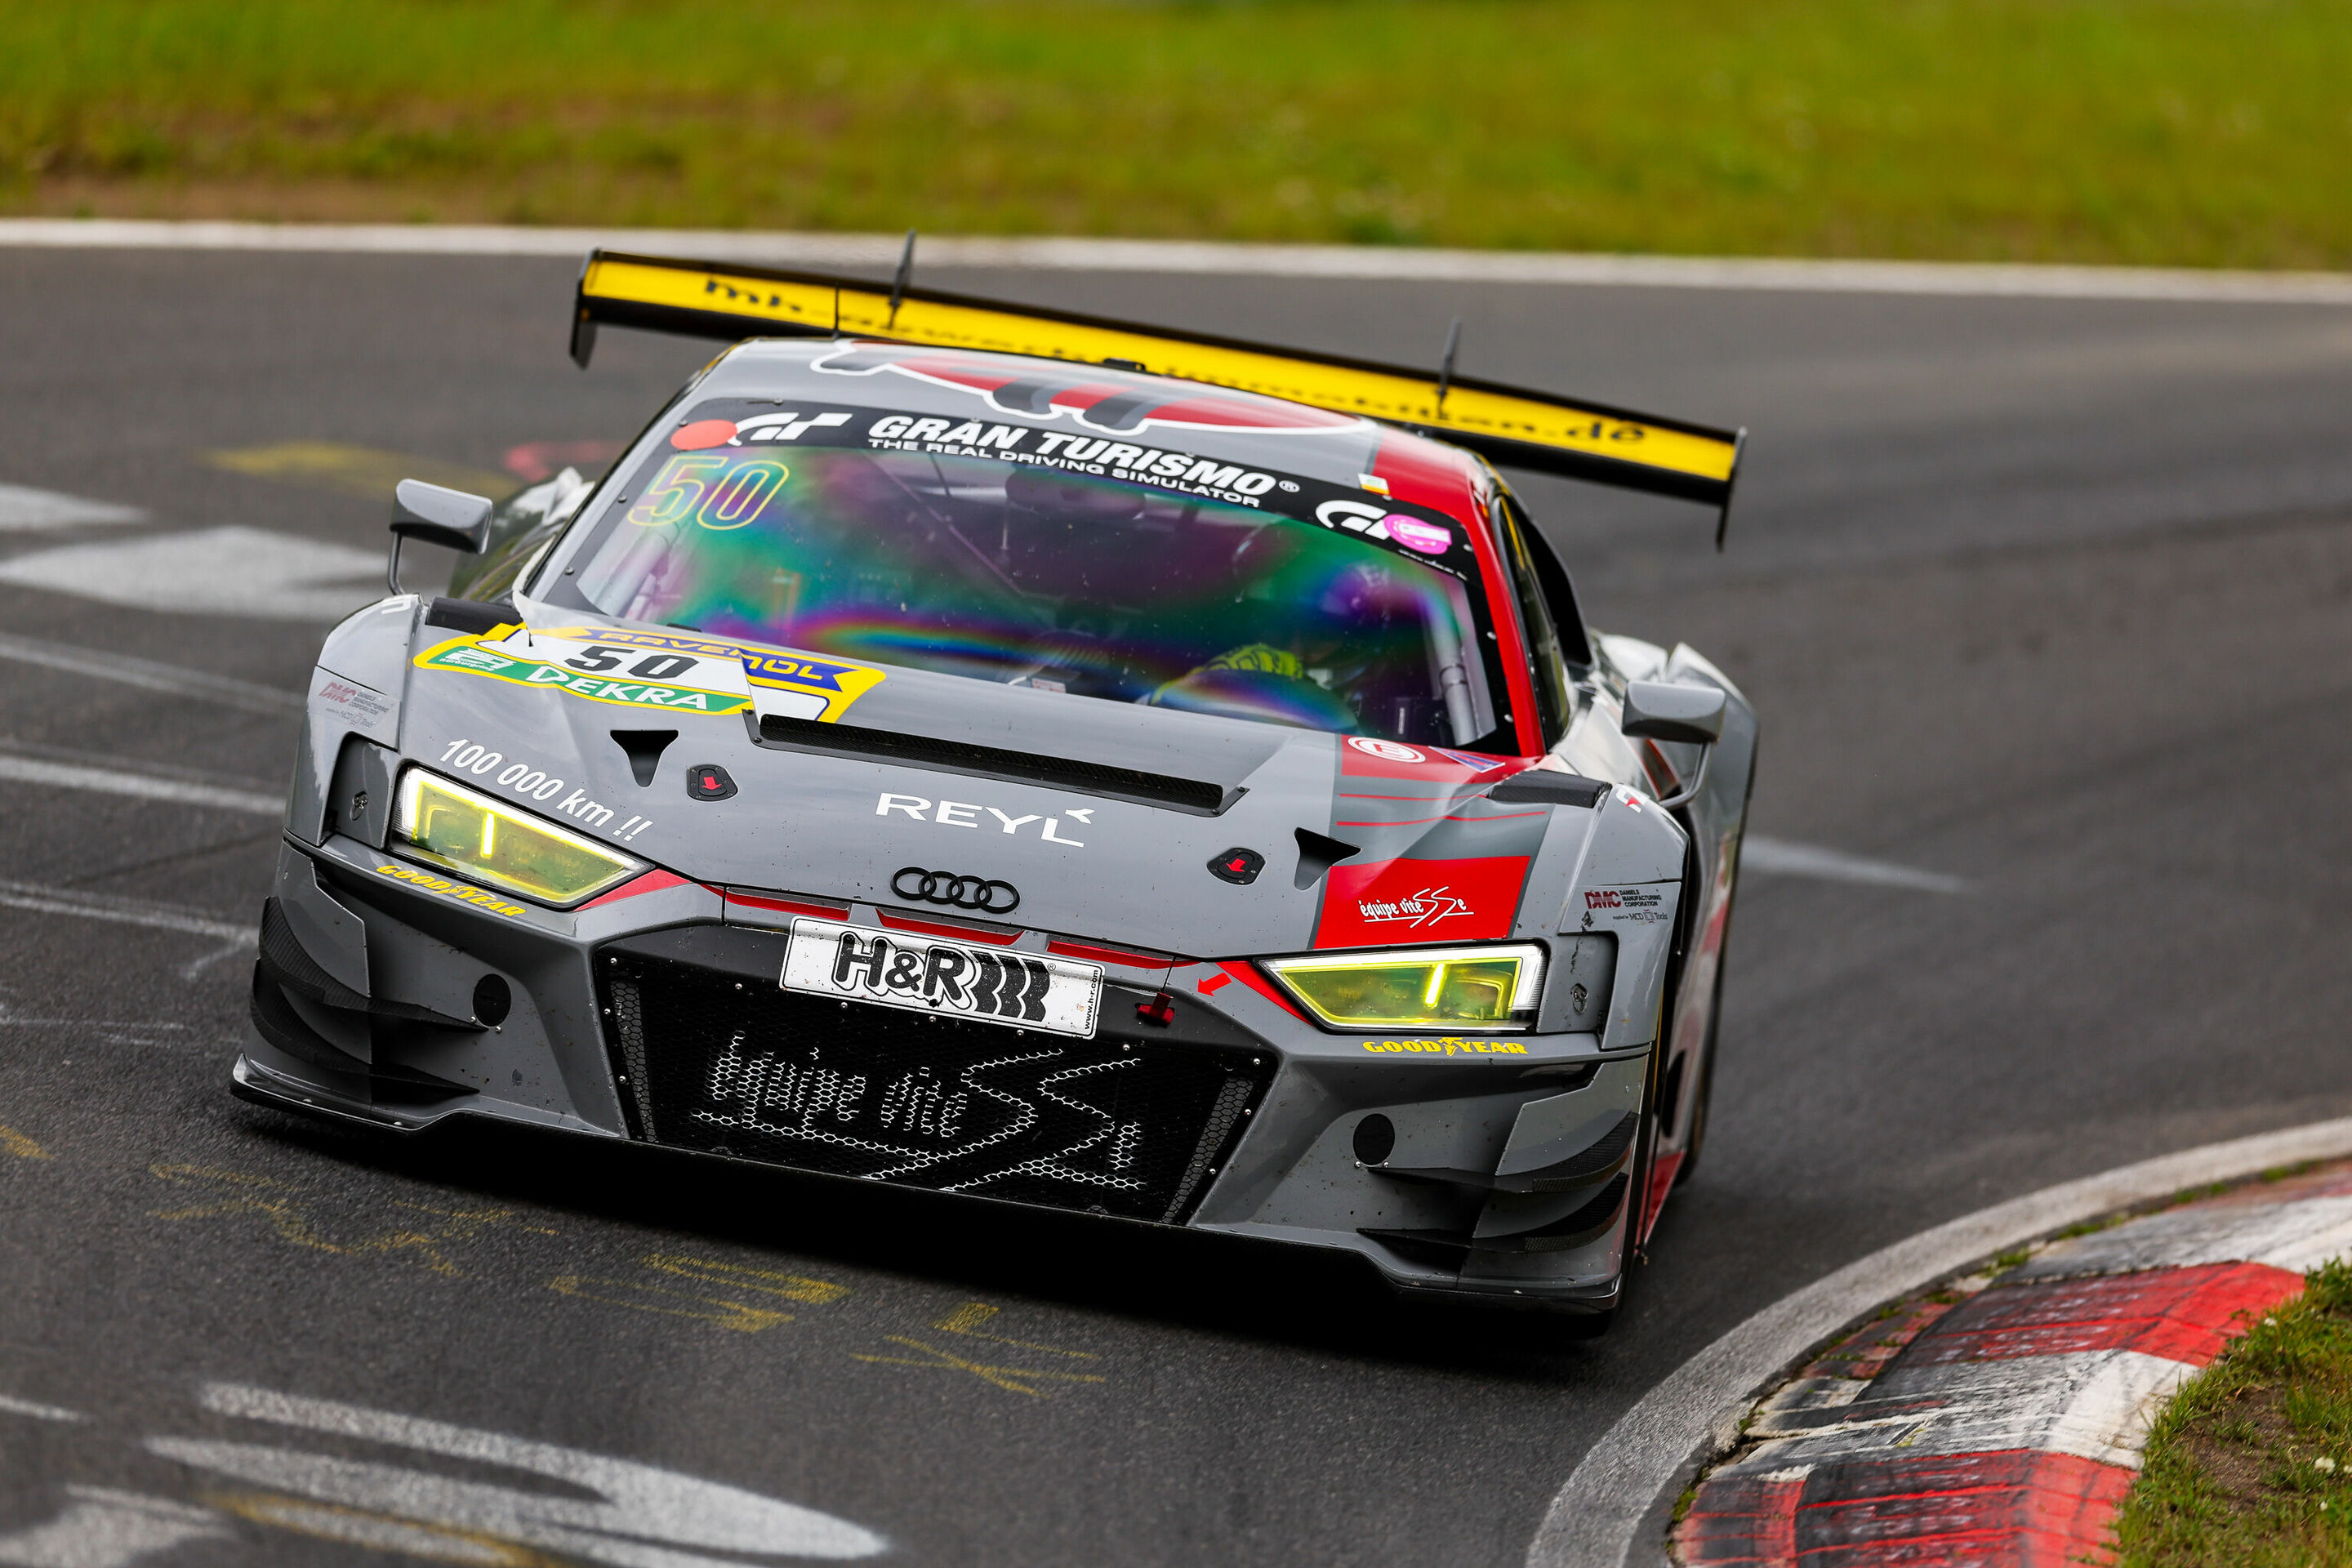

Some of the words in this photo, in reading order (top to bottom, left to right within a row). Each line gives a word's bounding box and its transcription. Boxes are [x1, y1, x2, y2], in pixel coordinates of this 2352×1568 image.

[867, 438, 918, 452] THE
[926, 441, 993, 459] REAL
[1000, 450, 1106, 475] DRIVING
[1111, 467, 1261, 508] SIMULATOR
[868, 415, 1029, 449] GRAN
[1036, 431, 1277, 496] TURISMO
[627, 455, 790, 531] 50
[525, 665, 707, 710] DEKRA
[564, 645, 700, 679] 50
[599, 632, 824, 680] RAVENOL
[439, 738, 503, 775] 100
[497, 764, 564, 800] 000
[556, 788, 615, 827] km
[612, 815, 653, 842] !!
[1584, 890, 1622, 909] DMC
[832, 931, 974, 1008] H&R
[1085, 969, 1099, 1030] www.h-r.com
